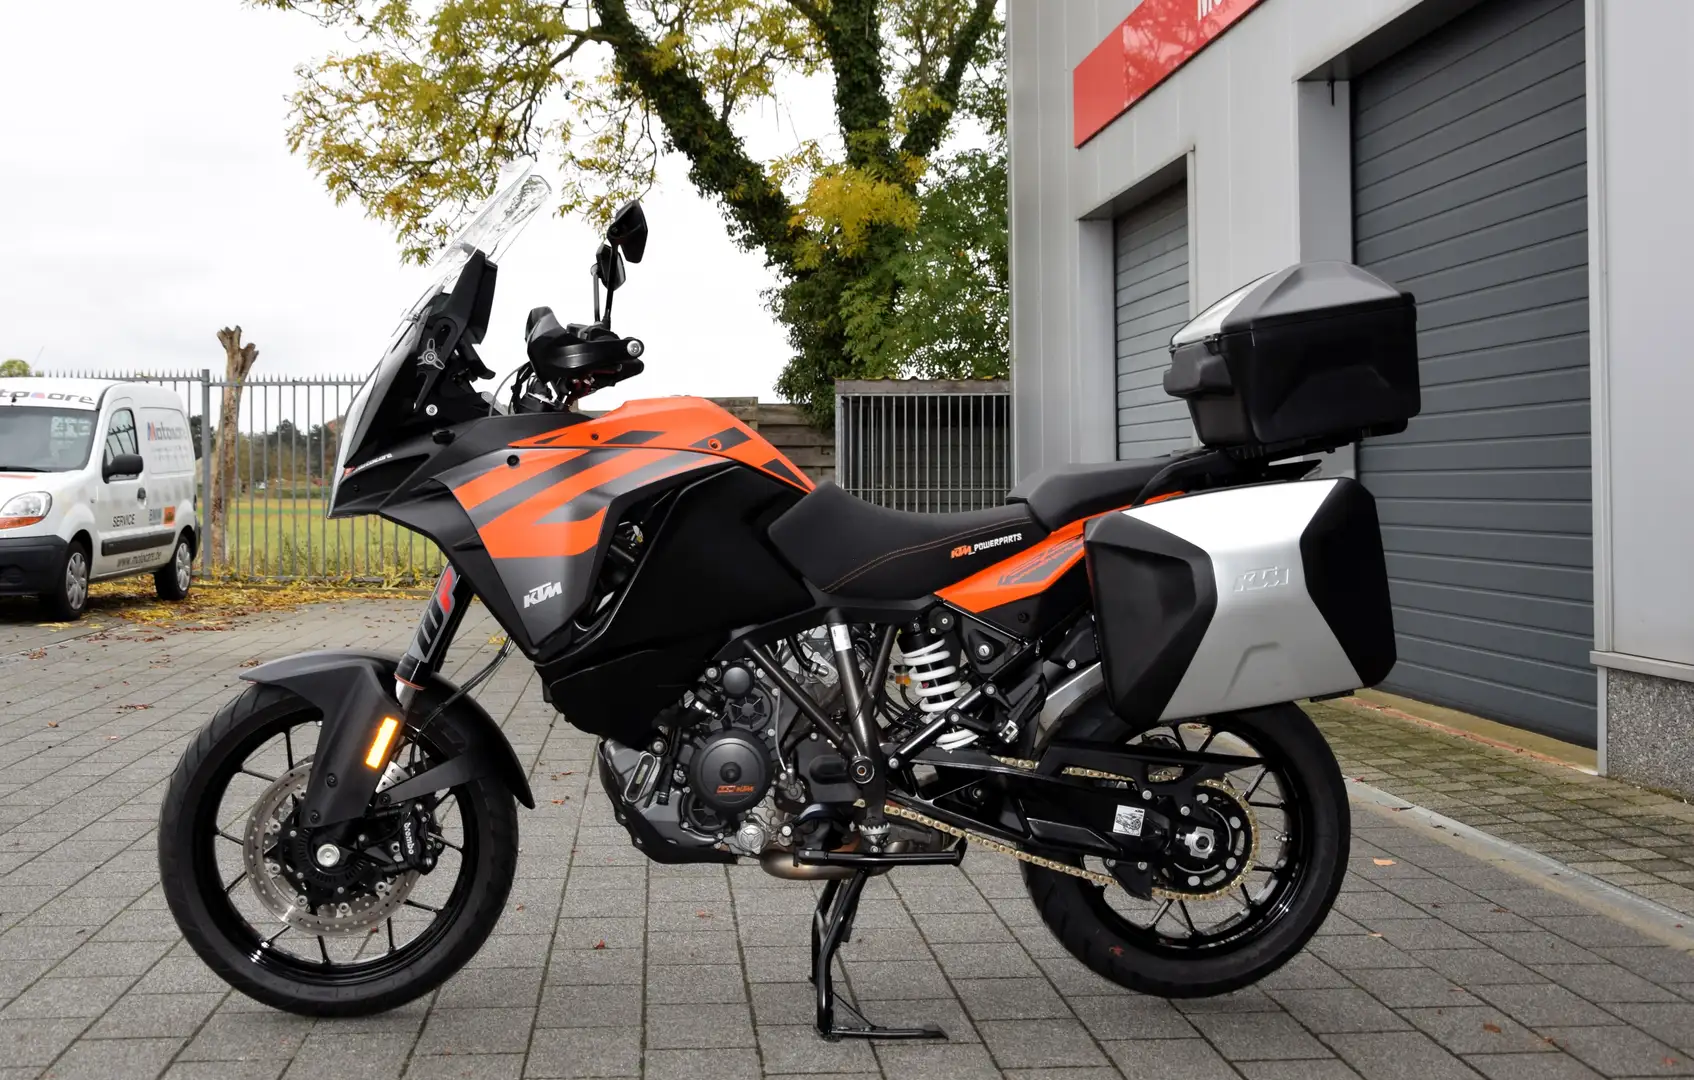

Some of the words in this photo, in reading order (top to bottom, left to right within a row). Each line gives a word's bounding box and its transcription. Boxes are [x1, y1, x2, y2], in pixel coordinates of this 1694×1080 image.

[112, 513, 135, 528] SERVICE
[523, 581, 562, 609] KTM
[403, 822, 415, 854] brembo
